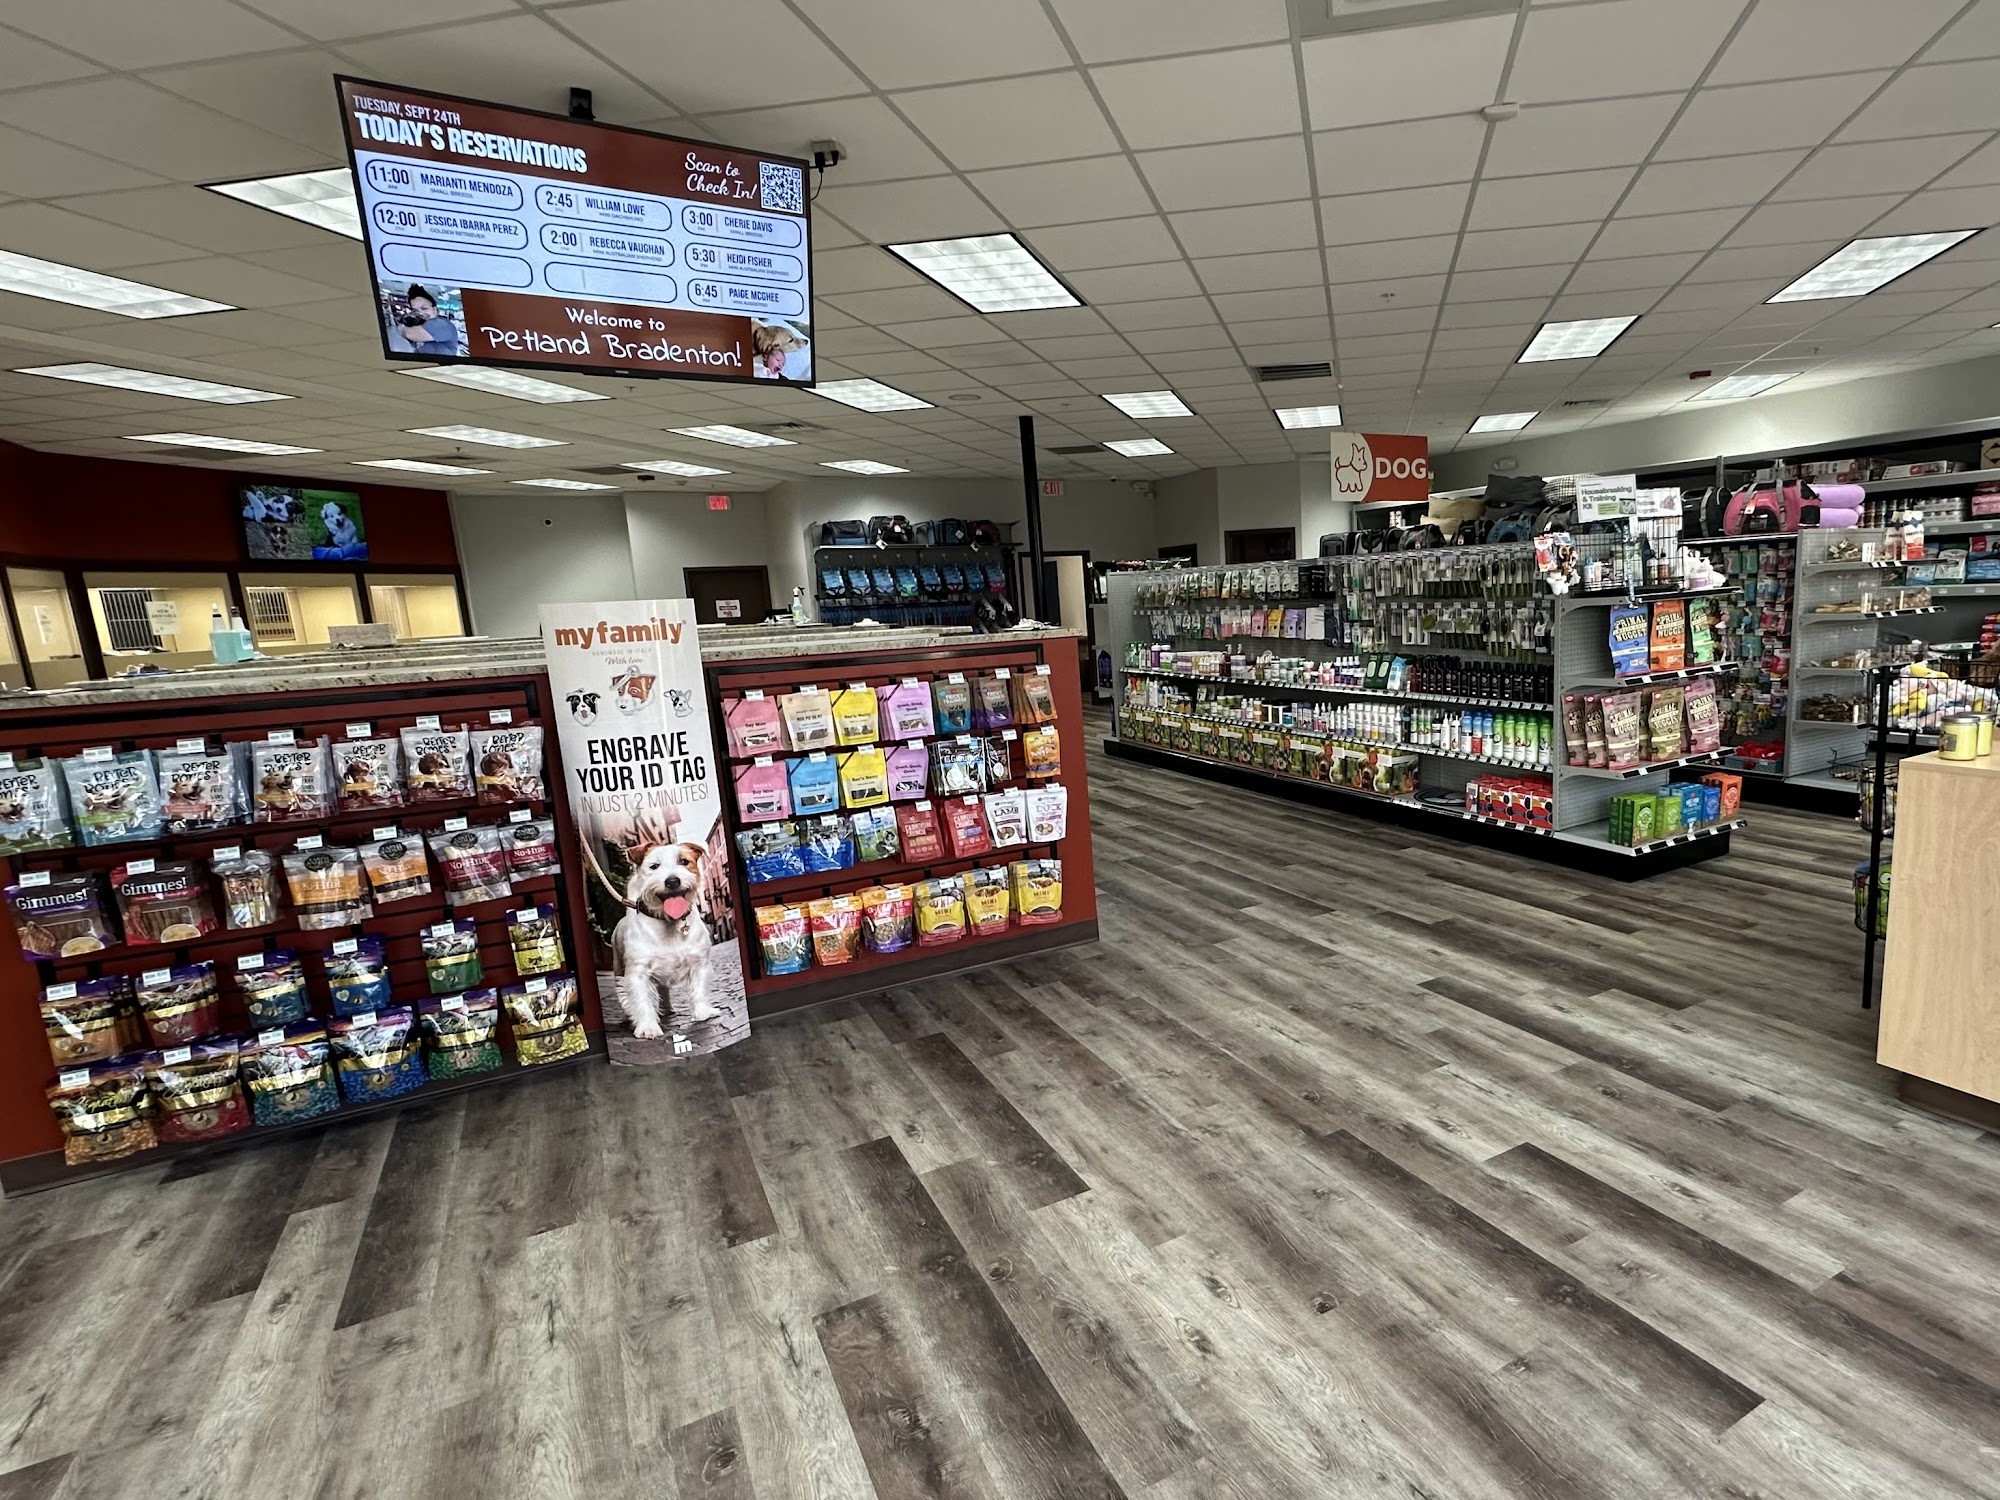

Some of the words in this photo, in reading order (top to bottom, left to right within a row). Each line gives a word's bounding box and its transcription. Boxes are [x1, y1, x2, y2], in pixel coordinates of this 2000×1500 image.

[352, 95, 402, 117] TUESDAY,
[404, 105, 429, 121] SEPT
[432, 109, 461, 125] 24TH
[354, 111, 445, 151] TODAY'S
[447, 127, 588, 174] RESERVATIONS
[685, 152, 722, 176] Scan
[725, 160, 740, 177] to
[370, 165, 409, 185] 11:00
[420, 173, 467, 190] MARIANTI
[469, 180, 513, 197] MENDOZA
[686, 172, 729, 196] Check
[732, 181, 758, 200] In!
[546, 190, 572, 208] 2:45
[585, 197, 621, 212] WILLIAM
[623, 203, 645, 216] LOWE
[378, 209, 416, 227] 12:00
[424, 214, 458, 228] JESSICA
[459, 219, 491, 232] IBARRA
[493, 223, 519, 236] PEREZ
[689, 210, 713, 226] 3:00
[724, 216, 750, 229] CHERIE
[752, 220, 773, 233] DAVIS
[551, 230, 577, 246] 2:00
[589, 236, 626, 250] REBECCA
[628, 242, 664, 255] VAUGHAN
[692, 248, 715, 263] 5:30
[727, 253, 745, 264] HEIDI
[748, 256, 772, 268] FISHER
[695, 284, 717, 298] 6:45
[729, 288, 749, 299] PAIGE
[751, 291, 779, 303] MCGHEE
[565, 306, 643, 330] Welcome
[648, 317, 665, 331] to
[481, 326, 590, 355] Petland
[601, 333, 742, 367] Bradenton!
[1375, 457, 1427, 480] DOG
[1581, 486, 1632, 495] Housebreaking
[1615, 615, 1646, 629] PRIMAL
[605, 657, 626, 666] With
[627, 657, 643, 665] love
[422, 736, 456, 747] BETTER
[587, 731, 689, 765] ENGRAVE
[182, 761, 220, 772] BETTER
[273, 752, 312, 764] BETTER
[576, 766, 635, 794] YOUR
[641, 762, 663, 788] ID
[670, 756, 706, 785] TAG
[580, 796, 593, 814] IN
[598, 794, 629, 814] JUST
[633, 793, 645, 810] 2
[649, 783, 709, 808] MINUTES!
[994, 806, 1019, 817] LAMB
[1036, 803, 1062, 813] DUCK
[121, 876, 188, 896] Gimmes!
[15, 888, 88, 910] Gimmes!
